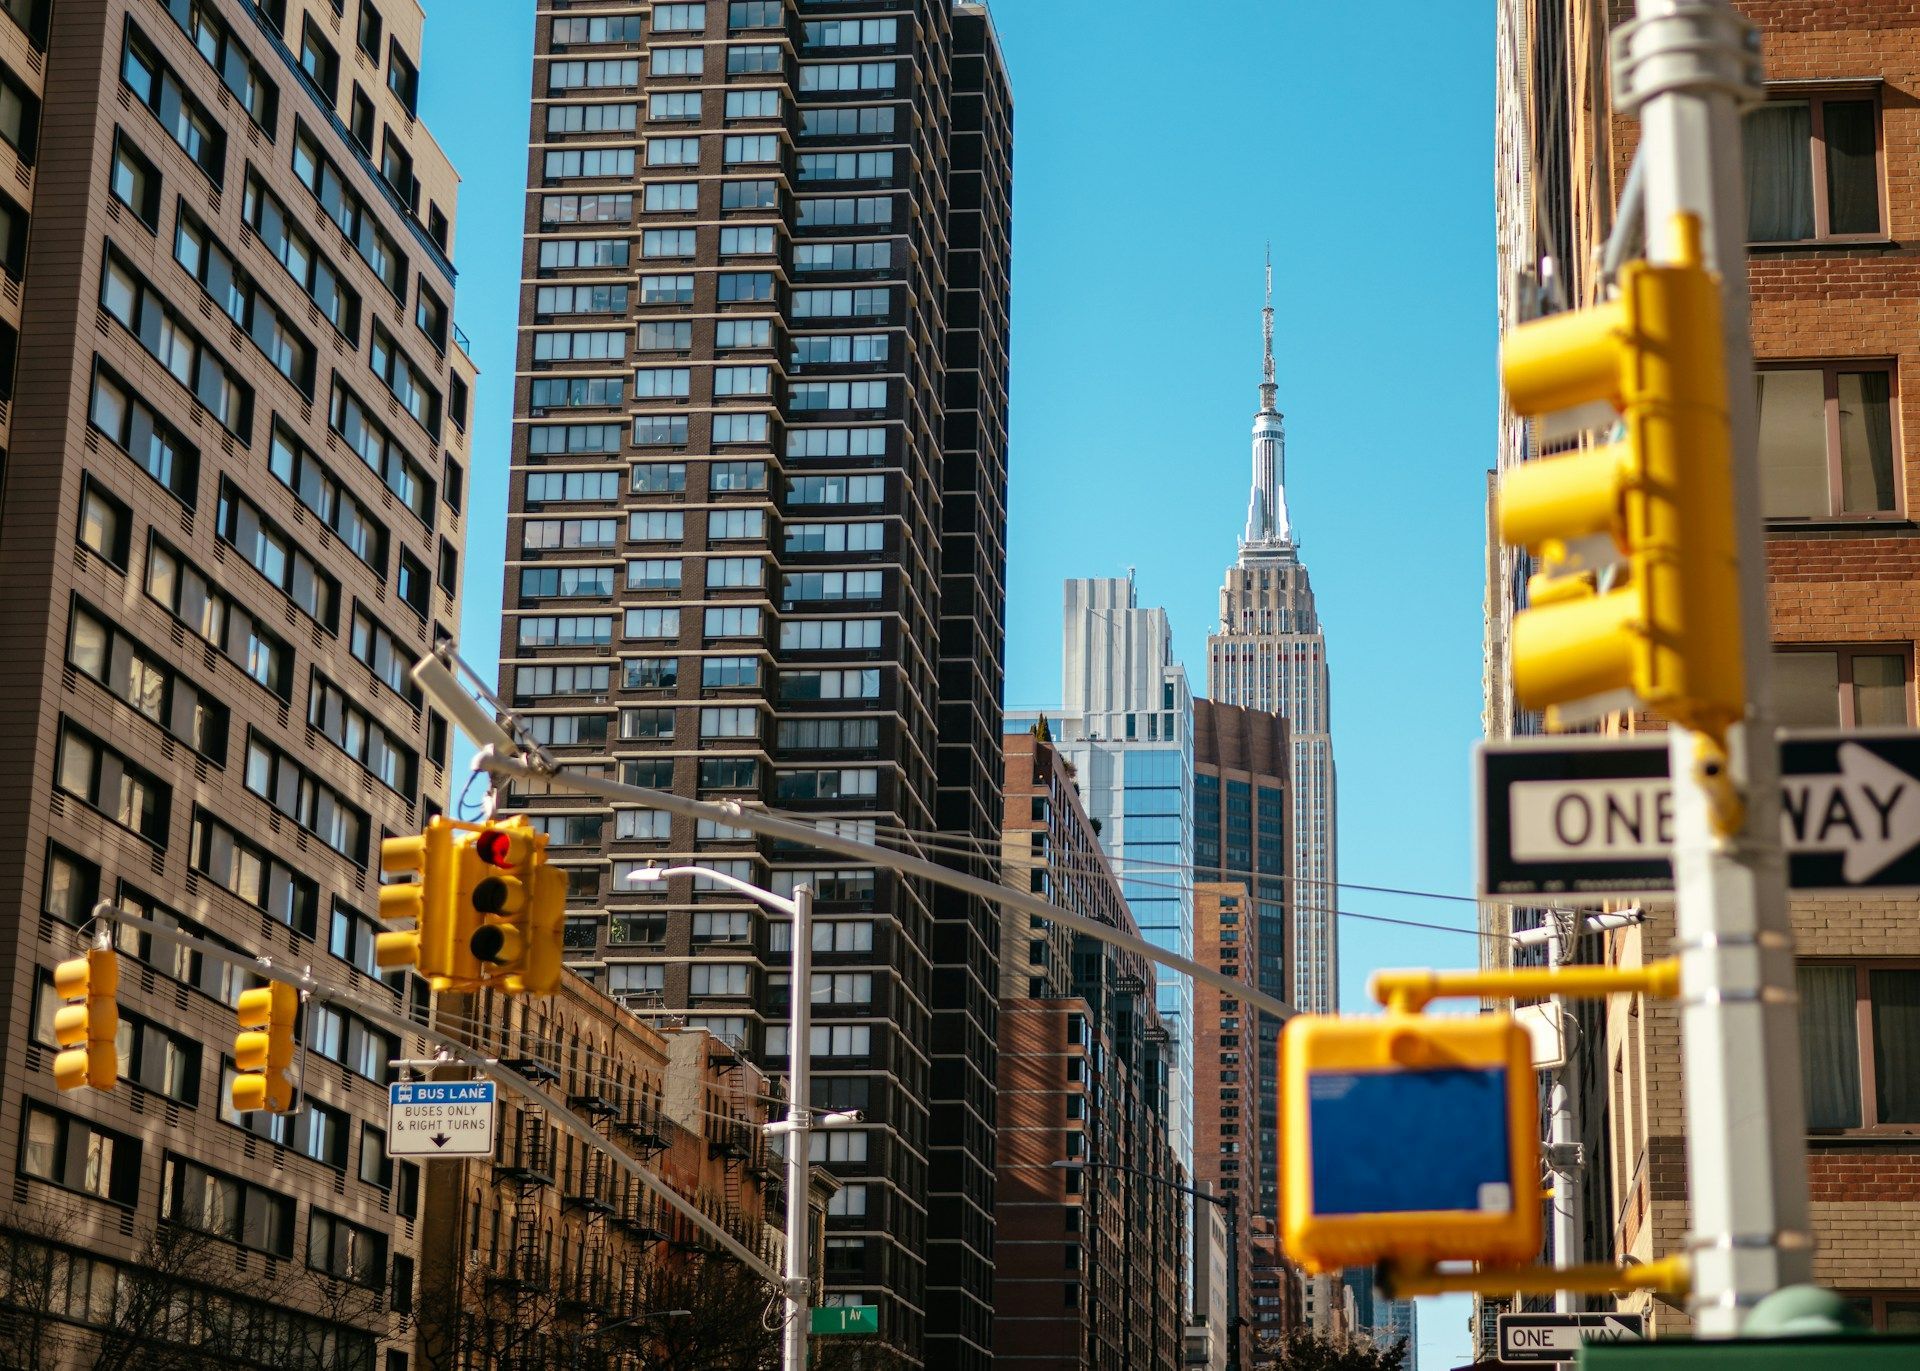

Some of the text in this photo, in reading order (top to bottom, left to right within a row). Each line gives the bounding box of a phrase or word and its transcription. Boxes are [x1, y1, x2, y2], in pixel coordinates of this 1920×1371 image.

[418, 1088, 486, 1099] BUS LANE
[405, 1105, 477, 1117] BUSES ONLY
[397, 1120, 485, 1131] & RIGHT TURNS
[840, 1308, 862, 1330] 1 Av
[1513, 1329, 1554, 1347] ONE
